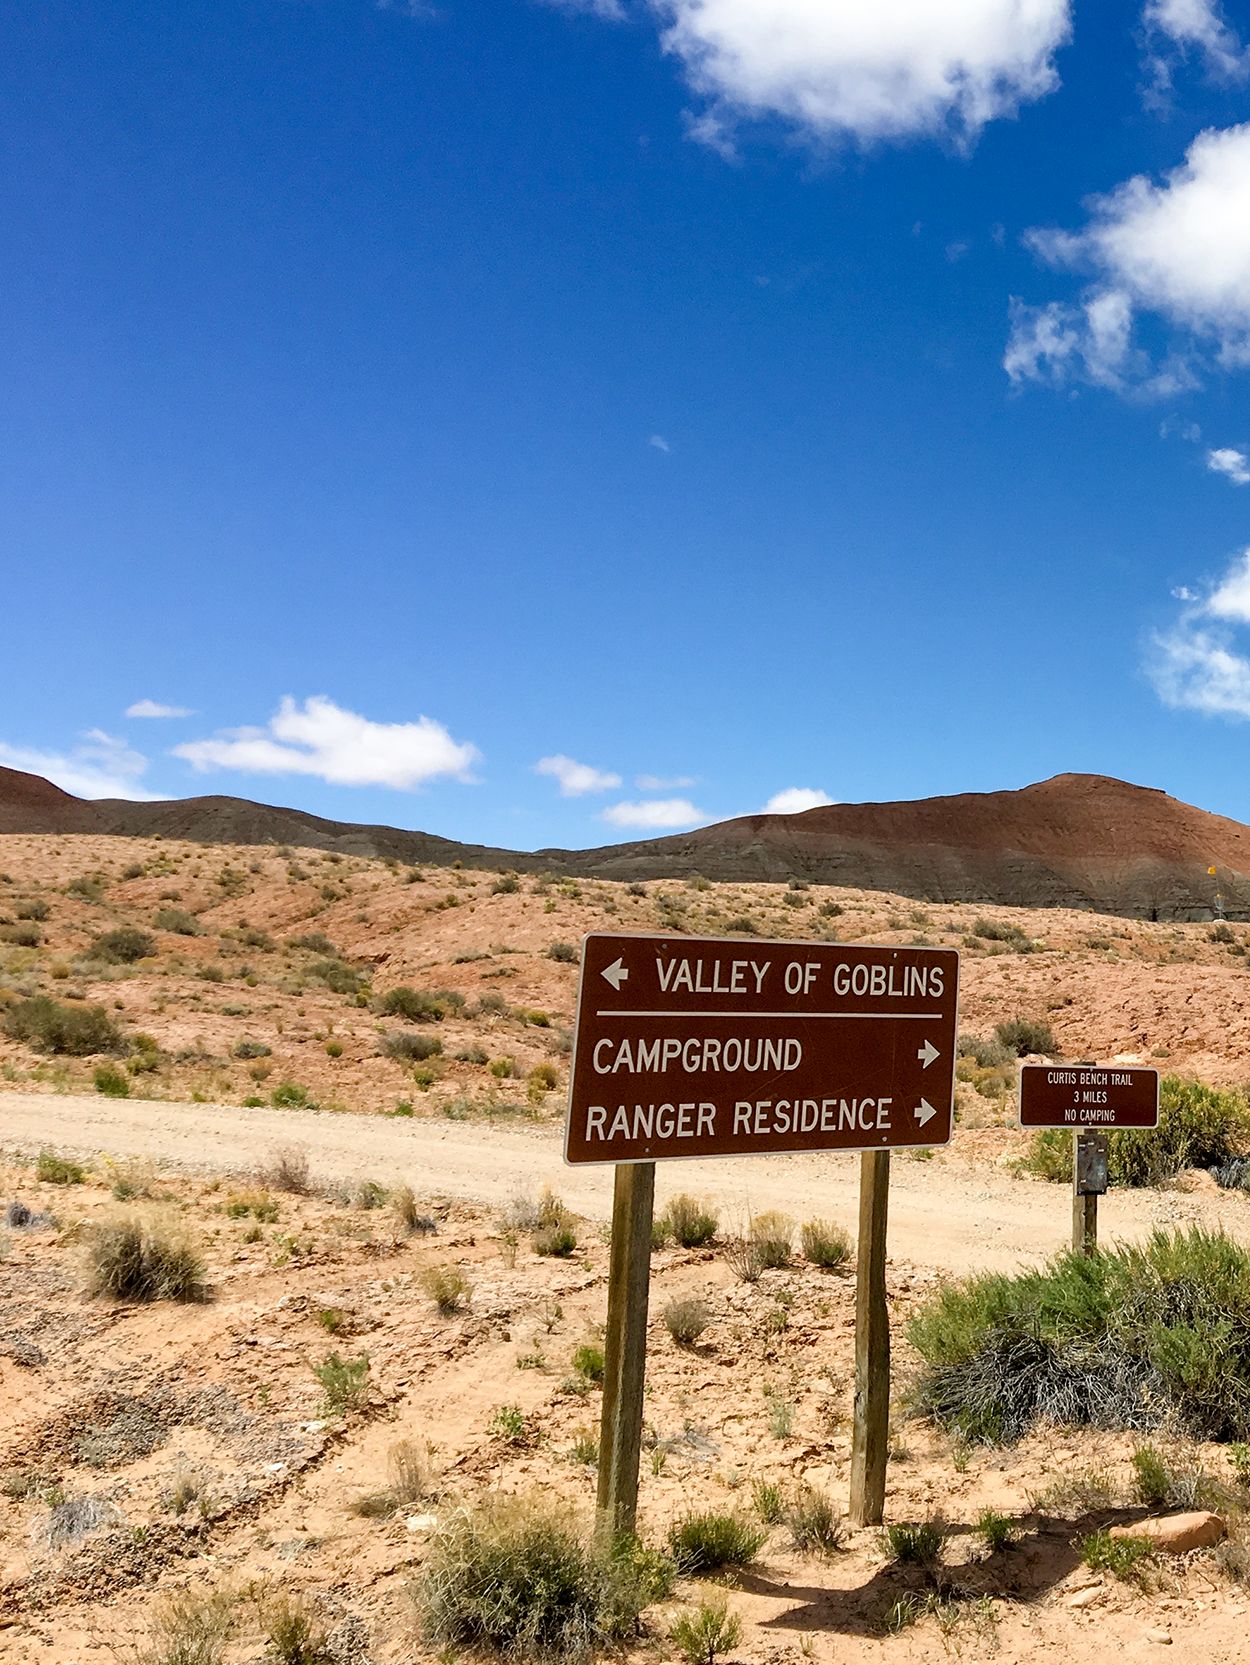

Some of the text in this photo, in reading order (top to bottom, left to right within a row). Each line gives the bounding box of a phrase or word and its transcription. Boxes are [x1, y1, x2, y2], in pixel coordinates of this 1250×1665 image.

[655, 958, 944, 998] VALLEY OF GOBLINS
[593, 1038, 802, 1074] CAMPGROUND
[1047, 1072, 1133, 1086] CURTIS BENCH TRAIL
[1073, 1090, 1107, 1103] 3 MILES
[585, 1097, 893, 1141] RANGER RESIDENCE
[1064, 1108, 1115, 1122] NO CAMPING
